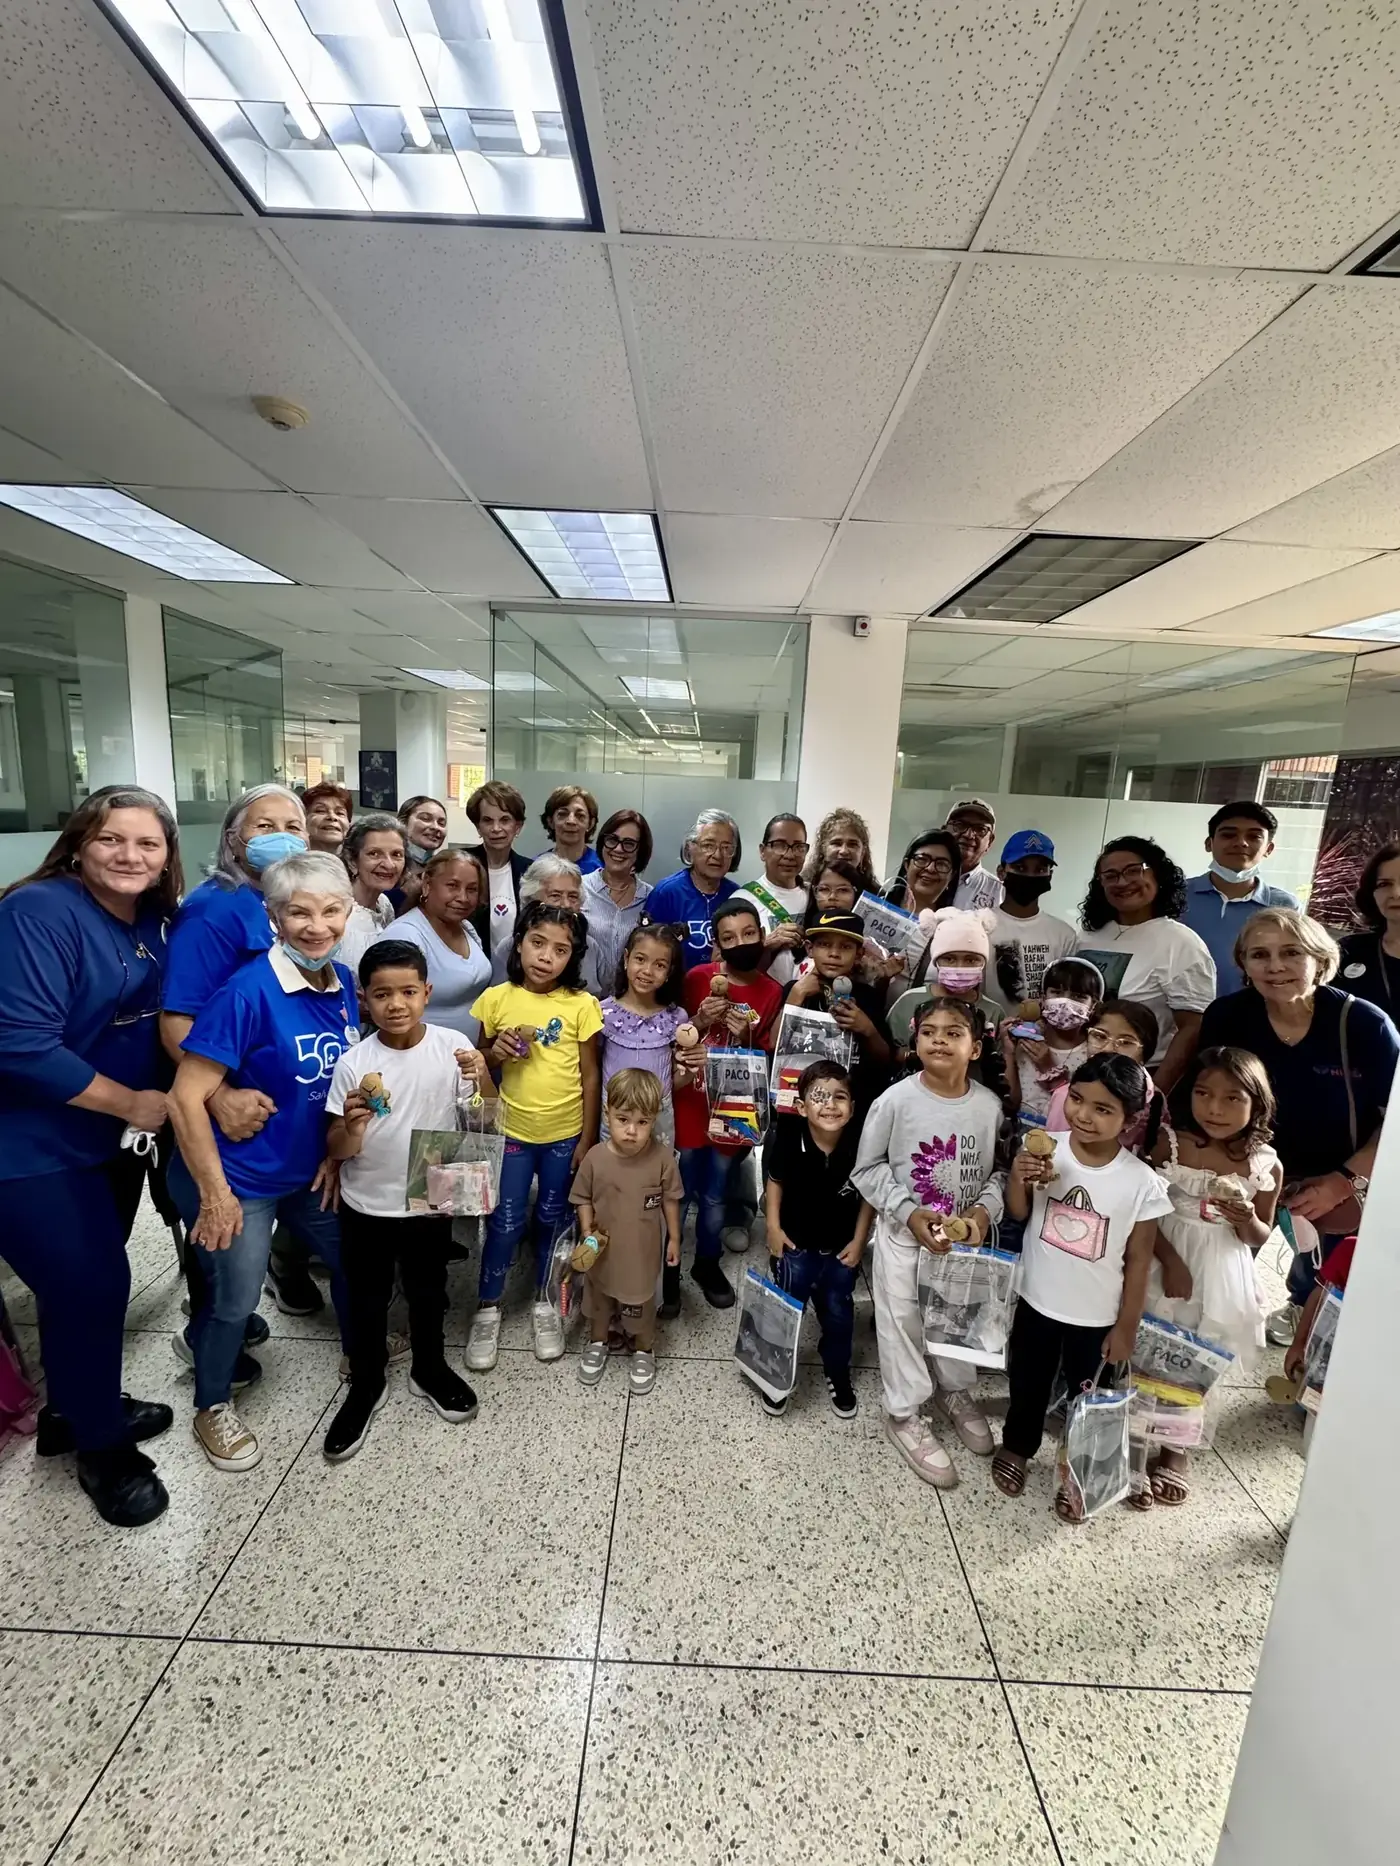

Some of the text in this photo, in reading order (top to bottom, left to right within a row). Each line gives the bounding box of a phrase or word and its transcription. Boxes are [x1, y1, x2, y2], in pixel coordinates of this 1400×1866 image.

[870, 919, 897, 938] PACO
[1022, 944, 1050, 953] YAHWEH
[725, 1069, 750, 1080] PACO
[960, 1134, 976, 1149] DO
[959, 1184, 977, 1199] YOU
